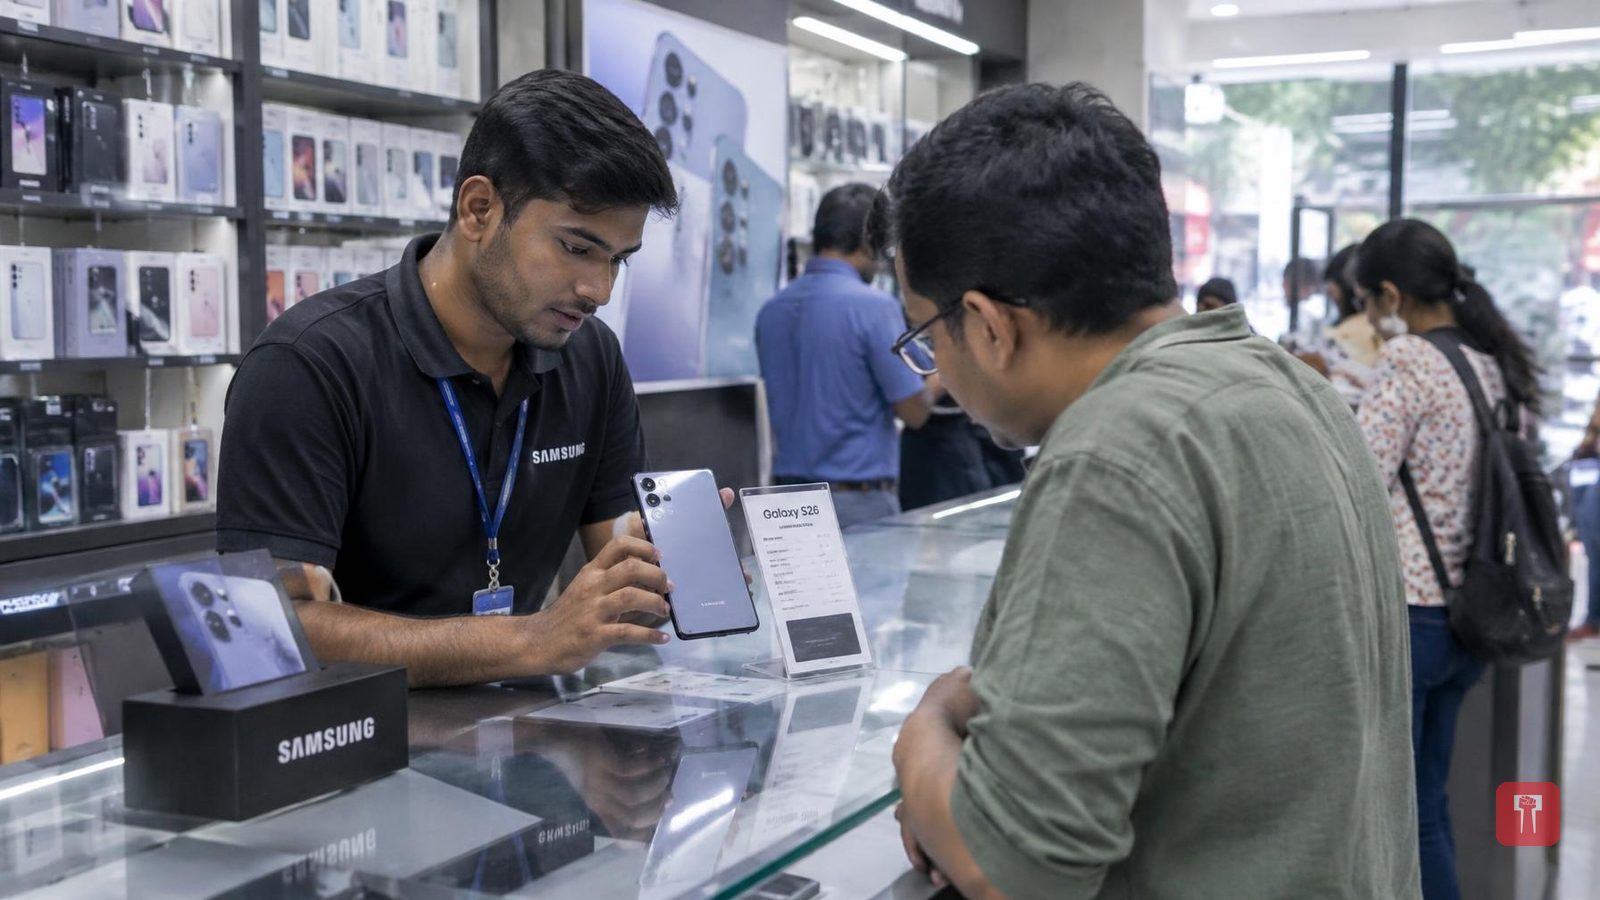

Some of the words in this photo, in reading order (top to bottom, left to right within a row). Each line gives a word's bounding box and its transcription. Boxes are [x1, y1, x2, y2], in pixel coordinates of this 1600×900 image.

[763, 508, 799, 519] Galaxy
[801, 505, 820, 516] S26
[278, 716, 375, 764] SAMSUNG
